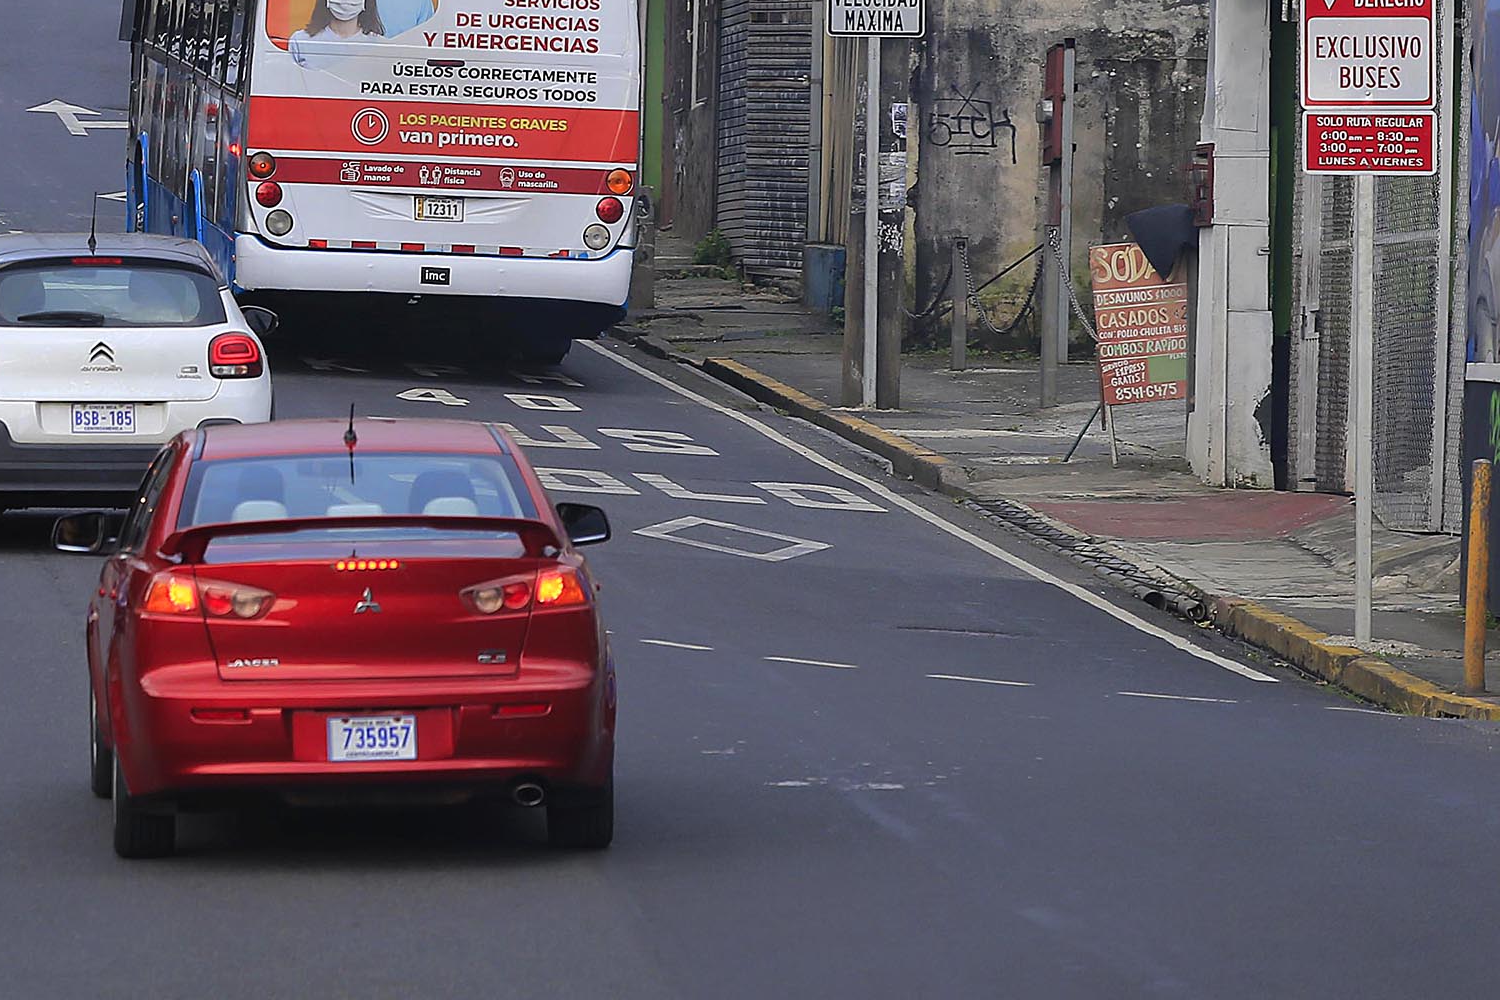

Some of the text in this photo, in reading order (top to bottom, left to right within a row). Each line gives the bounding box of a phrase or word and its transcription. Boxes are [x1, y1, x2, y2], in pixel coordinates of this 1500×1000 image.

[456, 13, 600, 32] DE URGENCIAS
[845, 10, 904, 31] MAXIMA
[423, 32, 600, 54] Y EMERGENCIAS
[1315, 36, 1421, 58] EXCLUSIVO
[393, 62, 597, 84] ÚSELOS CORRECTAMENTE
[1340, 66, 1401, 88] BUSES
[360, 82, 597, 102] PARA ESTAR SEGUROS TODOS
[399, 114, 568, 131] LOS PACIENTES GRAVES
[1316, 116, 1423, 128] SOLO RUTA REGULAR
[399, 131, 519, 148] van primero.
[364, 165, 404, 173] Lavado de
[1318, 157, 1423, 167] LUNES A VIERNES
[444, 168, 481, 176] Distancia
[518, 171, 545, 179] Uso de
[518, 180, 558, 189] mascarilla
[428, 203, 457, 216] 12311
[1092, 246, 1173, 284] SOD
[425, 270, 446, 281] imc
[1096, 290, 1153, 306] DESAYUNOS
[1099, 307, 1169, 328] CASADOS
[1100, 342, 1144, 357] COMBOS
[1115, 362, 1146, 377] EXPRESS
[75, 411, 132, 426] BSB-185
[483, 422, 720, 456] US
[533, 465, 888, 513] OLO
[343, 725, 410, 749] 735957
